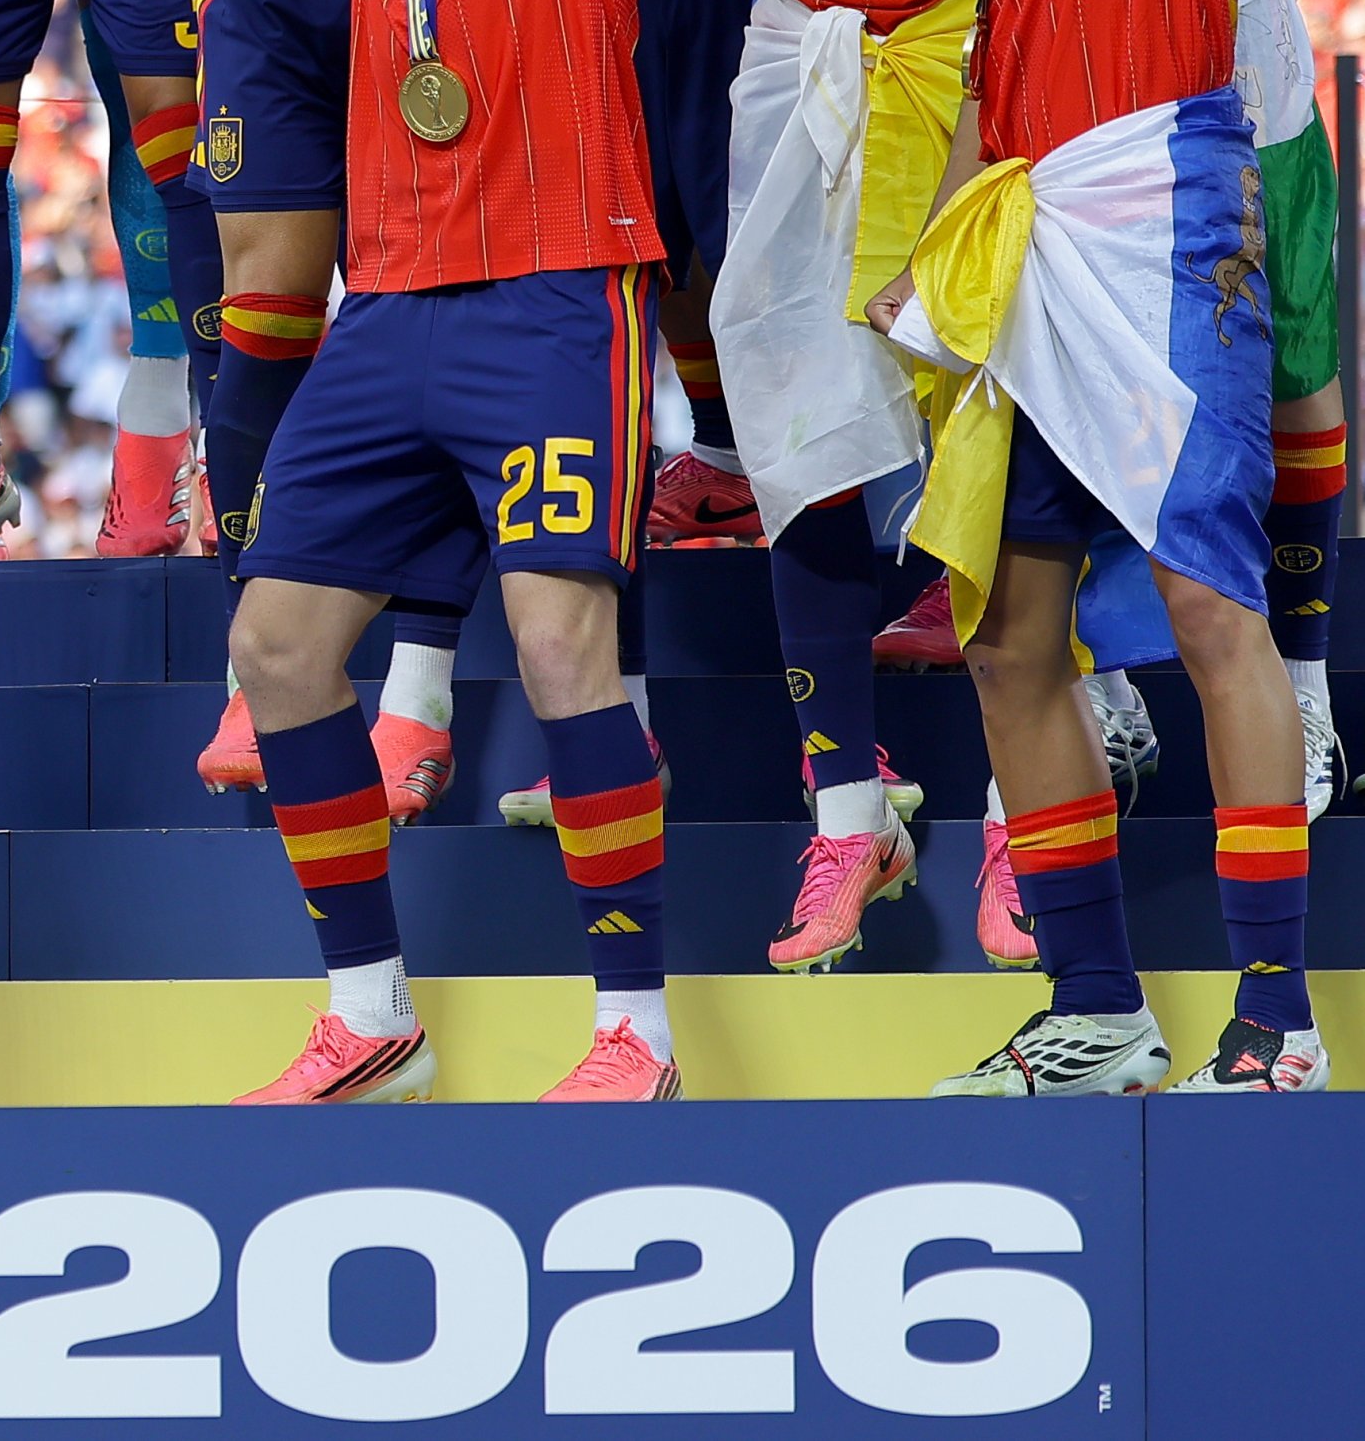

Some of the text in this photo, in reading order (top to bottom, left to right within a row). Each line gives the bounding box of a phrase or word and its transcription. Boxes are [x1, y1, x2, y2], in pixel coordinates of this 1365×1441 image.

[497, 439, 594, 544] 25
[1283, 549, 1311, 559] RF
[1285, 558, 1312, 567] EF
